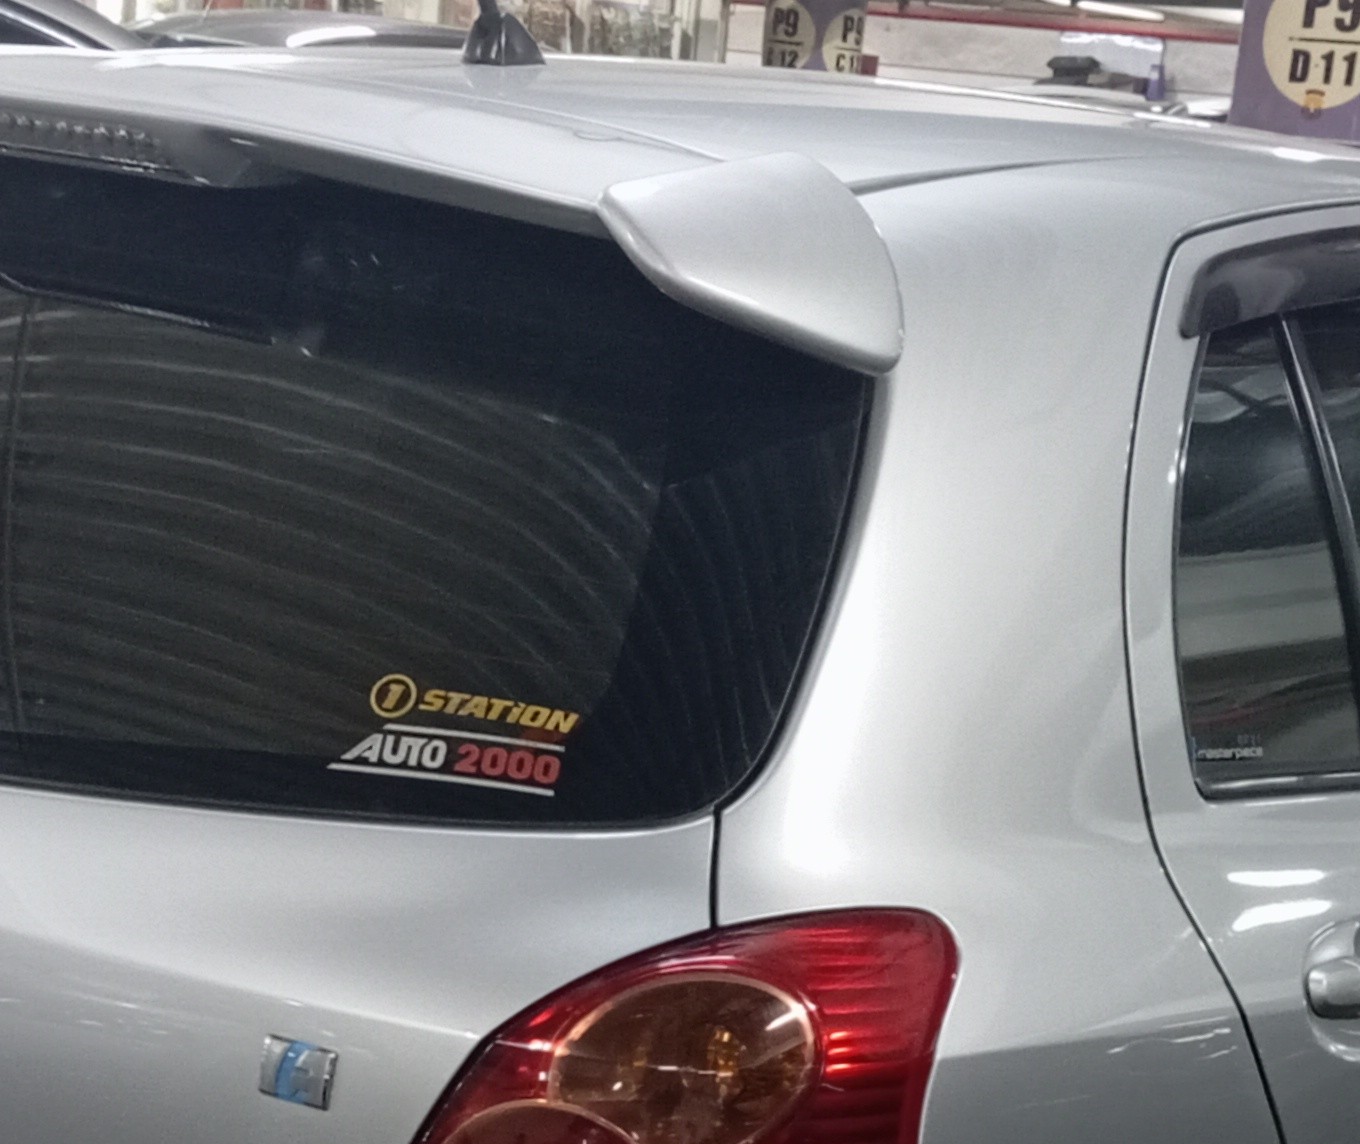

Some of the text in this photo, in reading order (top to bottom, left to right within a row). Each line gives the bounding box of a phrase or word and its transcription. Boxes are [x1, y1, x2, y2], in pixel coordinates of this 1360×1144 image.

[772, 7, 800, 38] P9
[340, 732, 562, 785] AUTO 2000
